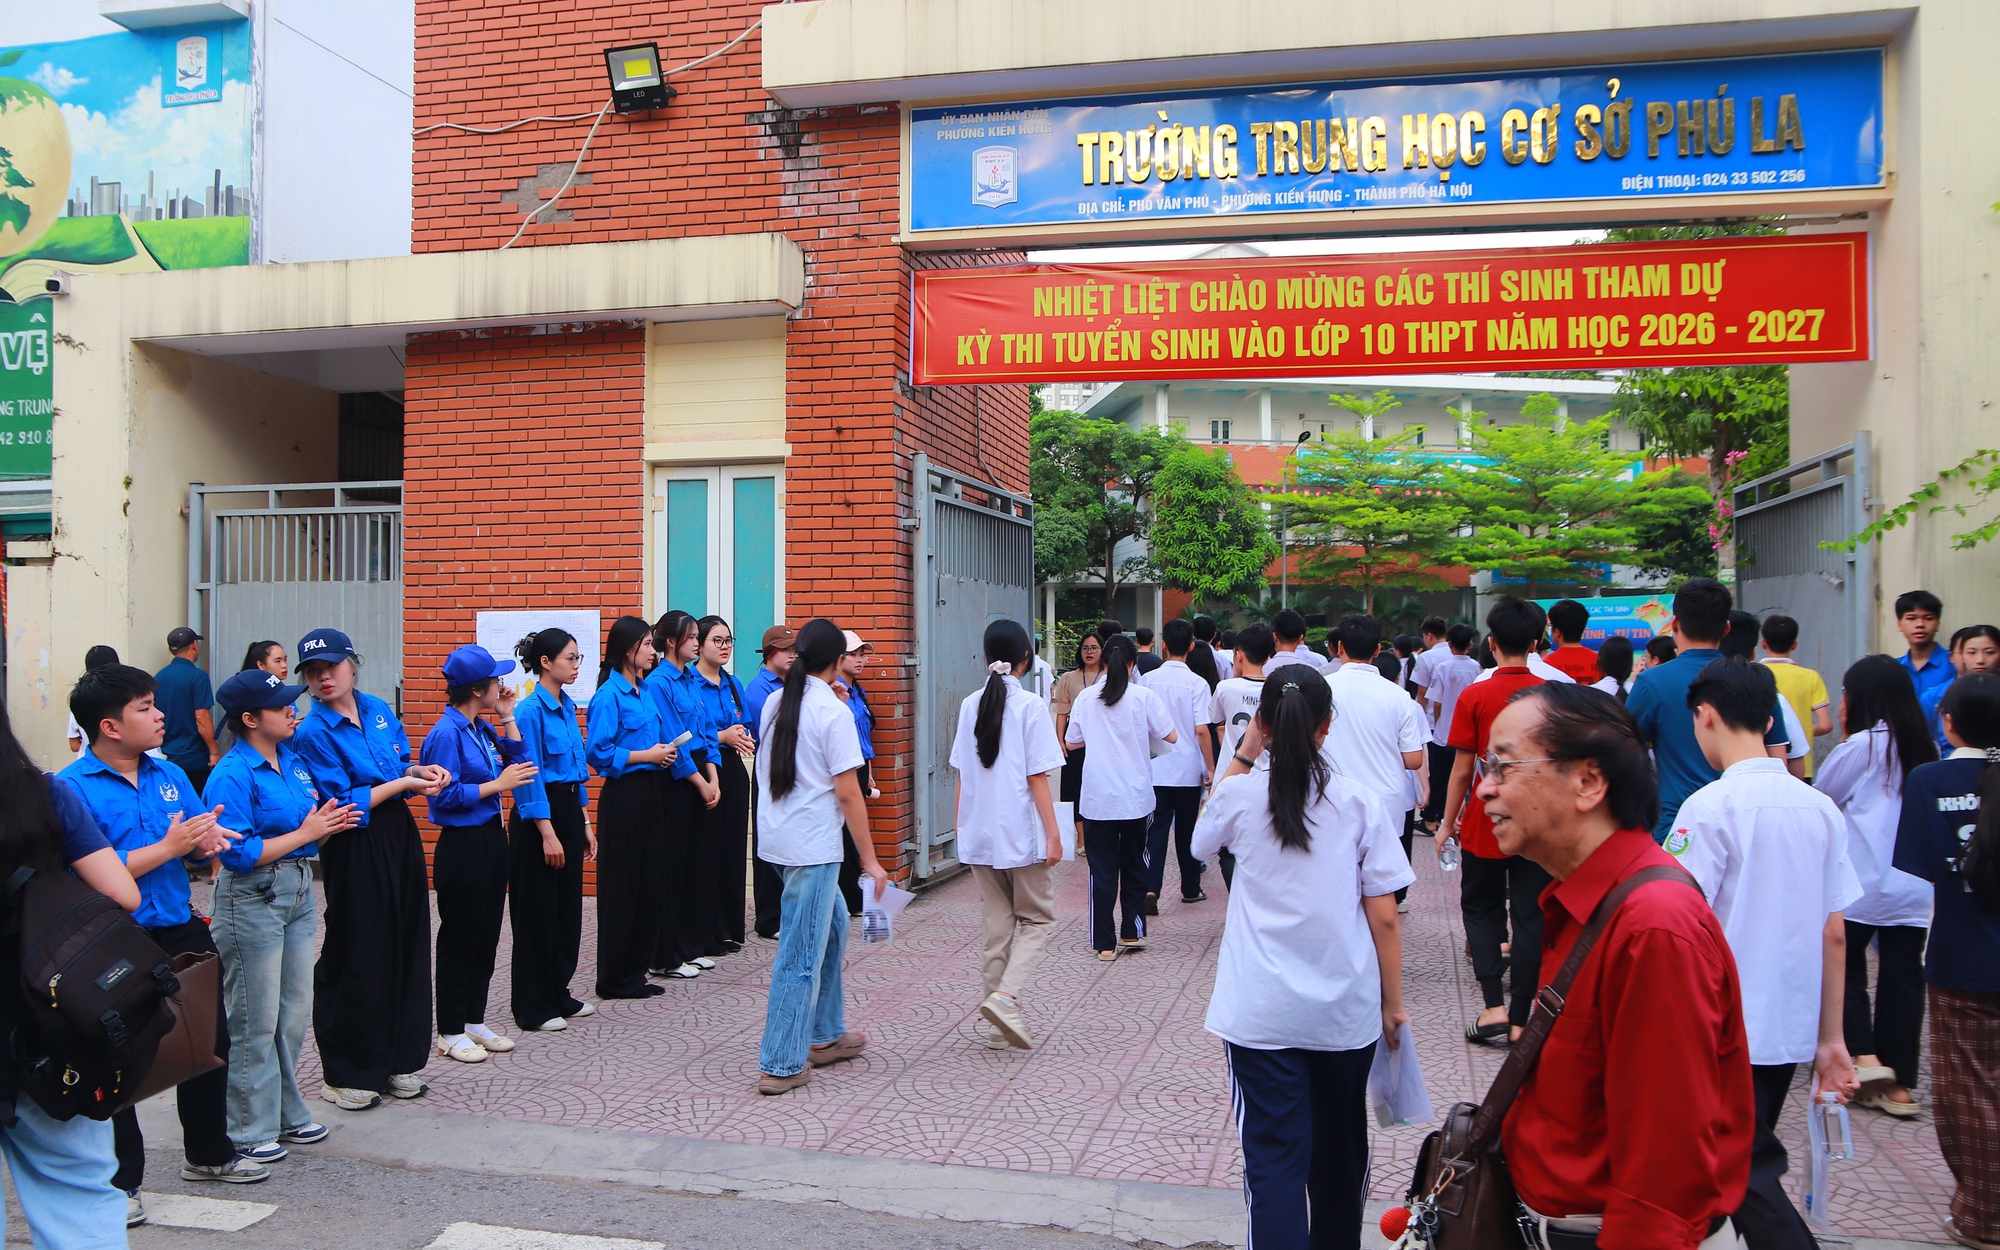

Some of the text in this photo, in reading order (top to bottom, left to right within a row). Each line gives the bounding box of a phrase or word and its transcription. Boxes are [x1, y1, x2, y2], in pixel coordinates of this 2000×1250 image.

[633, 90, 646, 98] LED
[942, 112, 956, 125] ỦY
[960, 113, 984, 124] BAN
[988, 109, 1020, 122] NHÂN
[937, 122, 1052, 140] PHƯỜNG KIẾN HƯNG
[1077, 78, 1806, 185] TRƯỜNG TRUNG HỌC CƠ SỞ PHÚ LA
[1622, 169, 1806, 192] ĐIỆN THOẠI: 024 33 502 256
[1078, 202, 1098, 216] ĐỊA
[1102, 196, 1125, 214] CHỈ:
[1156, 198, 1181, 210] VĂN
[1184, 195, 1209, 208] PHÚ
[1222, 190, 1272, 206] PHƯỜNG
[1275, 188, 1306, 204] KIẾN
[1308, 189, 1342, 203] HƯNG
[1354, 185, 1397, 201] THÀNH
[1400, 181, 1426, 199] PHỐ
[1430, 184, 1446, 198] HÀ
[1450, 182, 1472, 199] NỘI
[1034, 258, 1726, 322] NHIỆT LIỆT CHÀO MỪNG CÁC THÍ SINH THAM DỰ
[0, 313, 48, 376] VỆ
[958, 309, 1826, 366] KỲ THI TUYỂN SINH VÀO LỚP 10 THPT NĂM HỌC 2026 - 2027
[18, 430, 42, 444] 910
[1632, 628, 1650, 638] TIN
[304, 638, 327, 652] PKA
